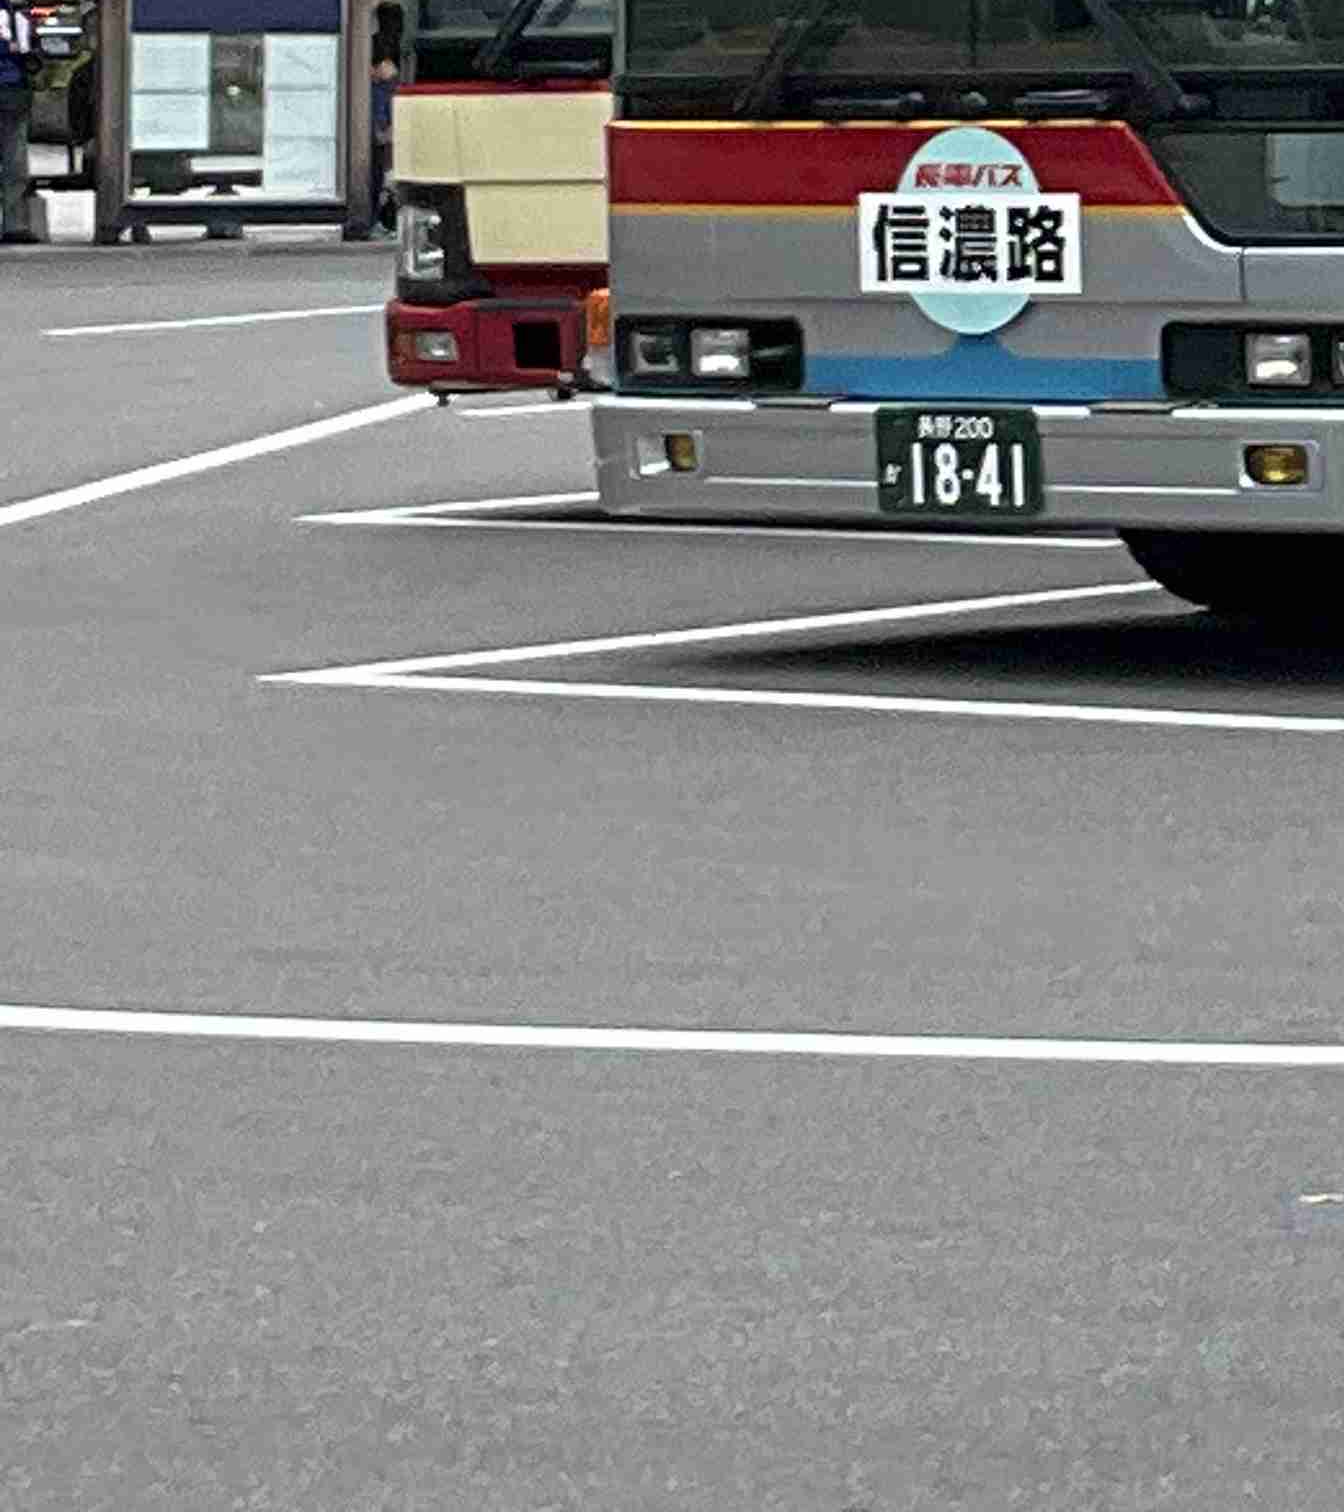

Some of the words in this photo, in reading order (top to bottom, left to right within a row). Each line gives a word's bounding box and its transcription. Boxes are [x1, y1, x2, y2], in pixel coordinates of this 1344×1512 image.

[914, 162, 1023, 188] 長電バス
[872, 203, 1067, 283] 信濃路
[954, 416, 995, 439] 200
